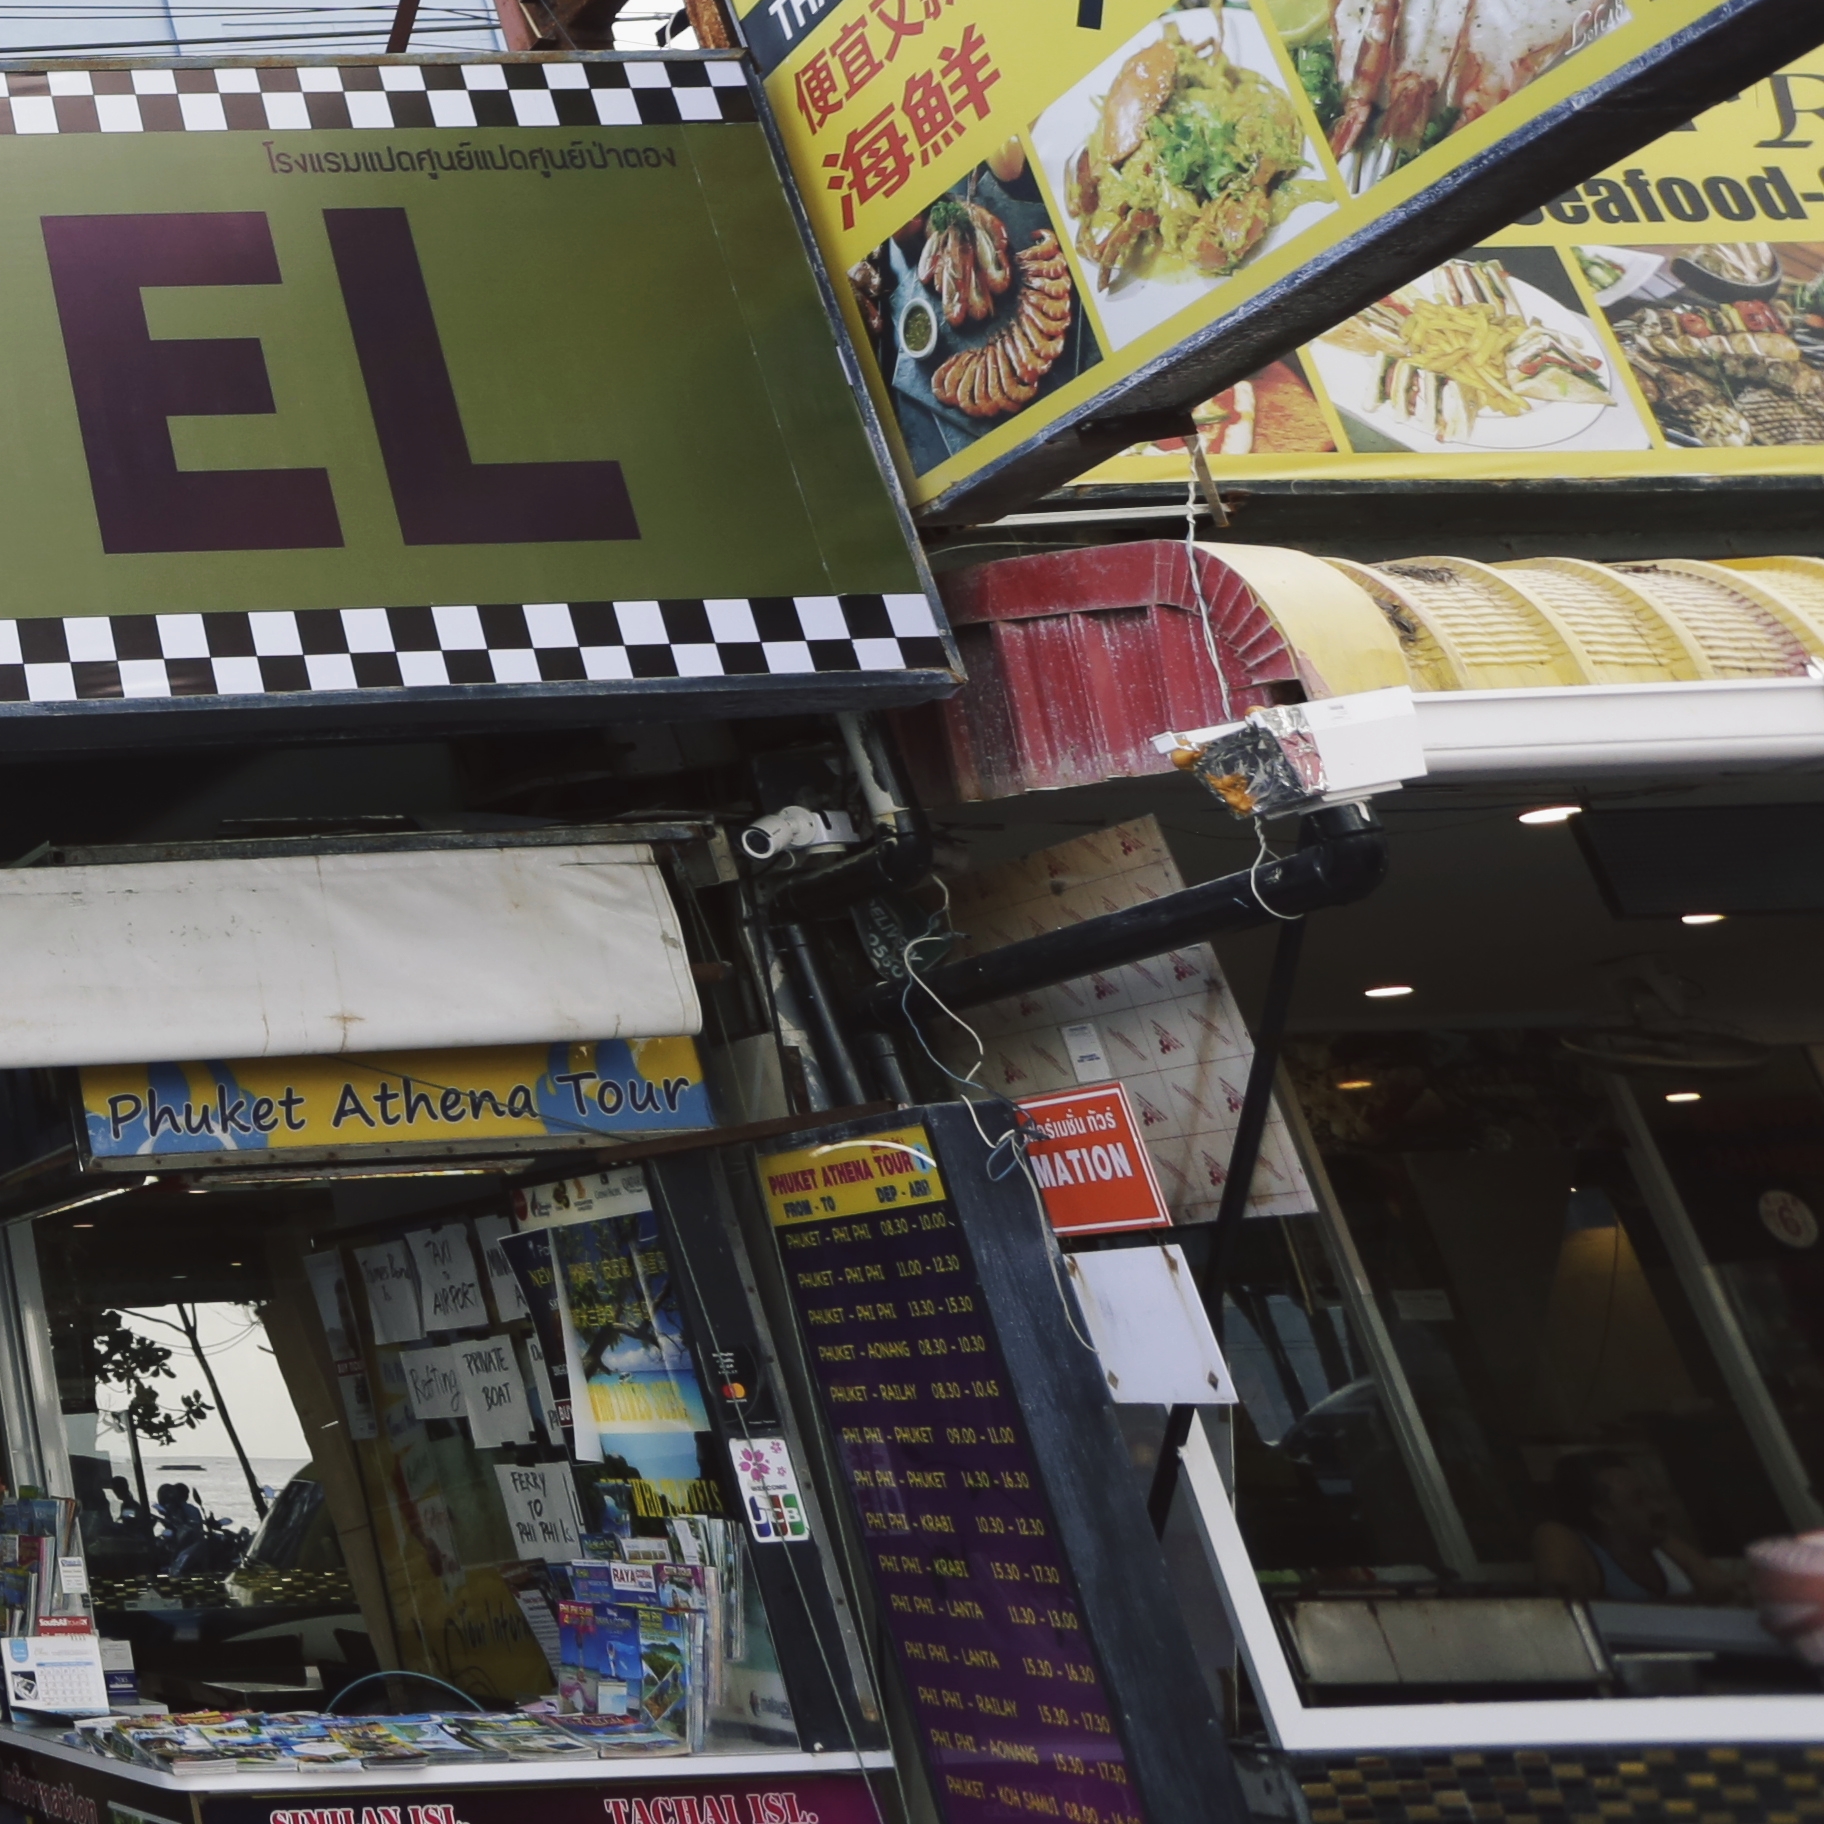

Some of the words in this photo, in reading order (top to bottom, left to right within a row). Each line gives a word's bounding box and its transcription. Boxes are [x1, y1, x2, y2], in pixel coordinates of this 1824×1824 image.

[820, 23, 1003, 231] 海鮮
[261, 139, 678, 179] โรงแรมแปดศูนย์แปดศูนย์ป่าตอง
[105, 1082, 309, 1140] Phuket
[329, 1074, 539, 1130] Athena
[555, 1070, 692, 1116] Tour
[768, 1168, 819, 1196] PHUKET
[821, 1158, 874, 1188] ATHENA
[873, 1150, 915, 1177] TOUR
[1029, 1142, 1134, 1189] MATION
[782, 1198, 814, 1219] FROM
[819, 1195, 836, 1212] TO
[875, 1185, 898, 1204] DEP
[786, 1231, 822, 1249] PHUKET
[832, 1226, 851, 1243] PHI
[851, 1223, 872, 1240] PHI
[433, 1281, 476, 1316] AIRPORT
[462, 1347, 510, 1377] PRIVATE
[817, 1344, 856, 1362] PHUKET
[867, 1340, 911, 1359] AONANG
[482, 1382, 512, 1411] BOAT
[829, 1385, 869, 1402] PHUKET
[878, 1383, 918, 1401] RAILAY
[510, 1471, 547, 1498] FERRY
[527, 1498, 543, 1520] TO
[865, 1512, 887, 1530] PHI
[888, 1512, 911, 1530] PHI
[919, 1514, 955, 1533] KRABI
[516, 1521, 537, 1544] PHI
[539, 1521, 560, 1543] PHI
[889, 1594, 912, 1613] PHI
[912, 1595, 936, 1614] PHI
[945, 1599, 985, 1620] LANTA
[930, 1728, 953, 1750] PHI
[954, 1732, 978, 1754] PHI
[989, 1738, 1040, 1765] AONANG
[603, 1795, 738, 1824] TACHAI
[746, 1792, 819, 1824] ISL.
[945, 1774, 987, 1800] PHUKET
[998, 1785, 1022, 1810] KOH
[1021, 1791, 1061, 1816] SAMUI
